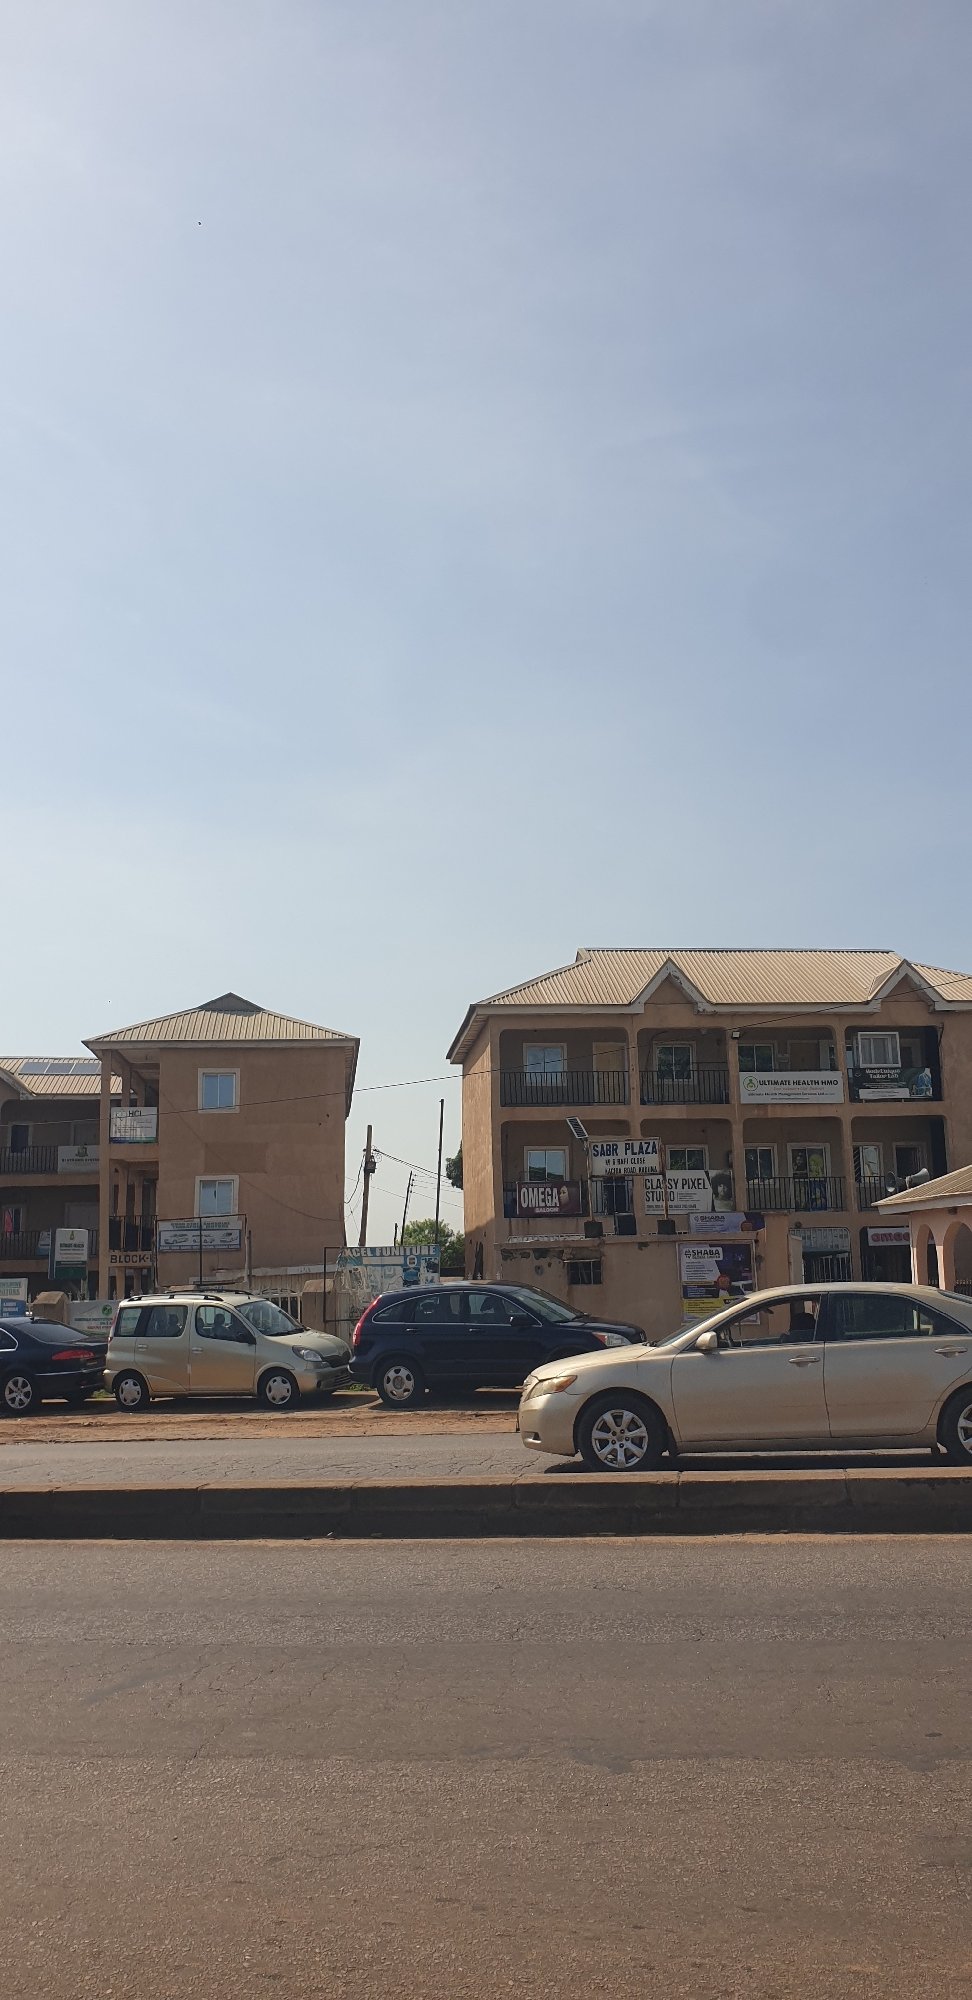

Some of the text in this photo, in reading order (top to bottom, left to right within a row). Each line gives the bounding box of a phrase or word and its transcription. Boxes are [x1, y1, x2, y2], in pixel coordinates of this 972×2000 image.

[592, 1141, 658, 1157] SABR PLAZA
[630, 1157, 646, 1165] CLOSE
[644, 1177, 709, 1190] CLASY PIXEL
[520, 1187, 560, 1208] OMEGA
[645, 1190, 675, 1202] STUO
